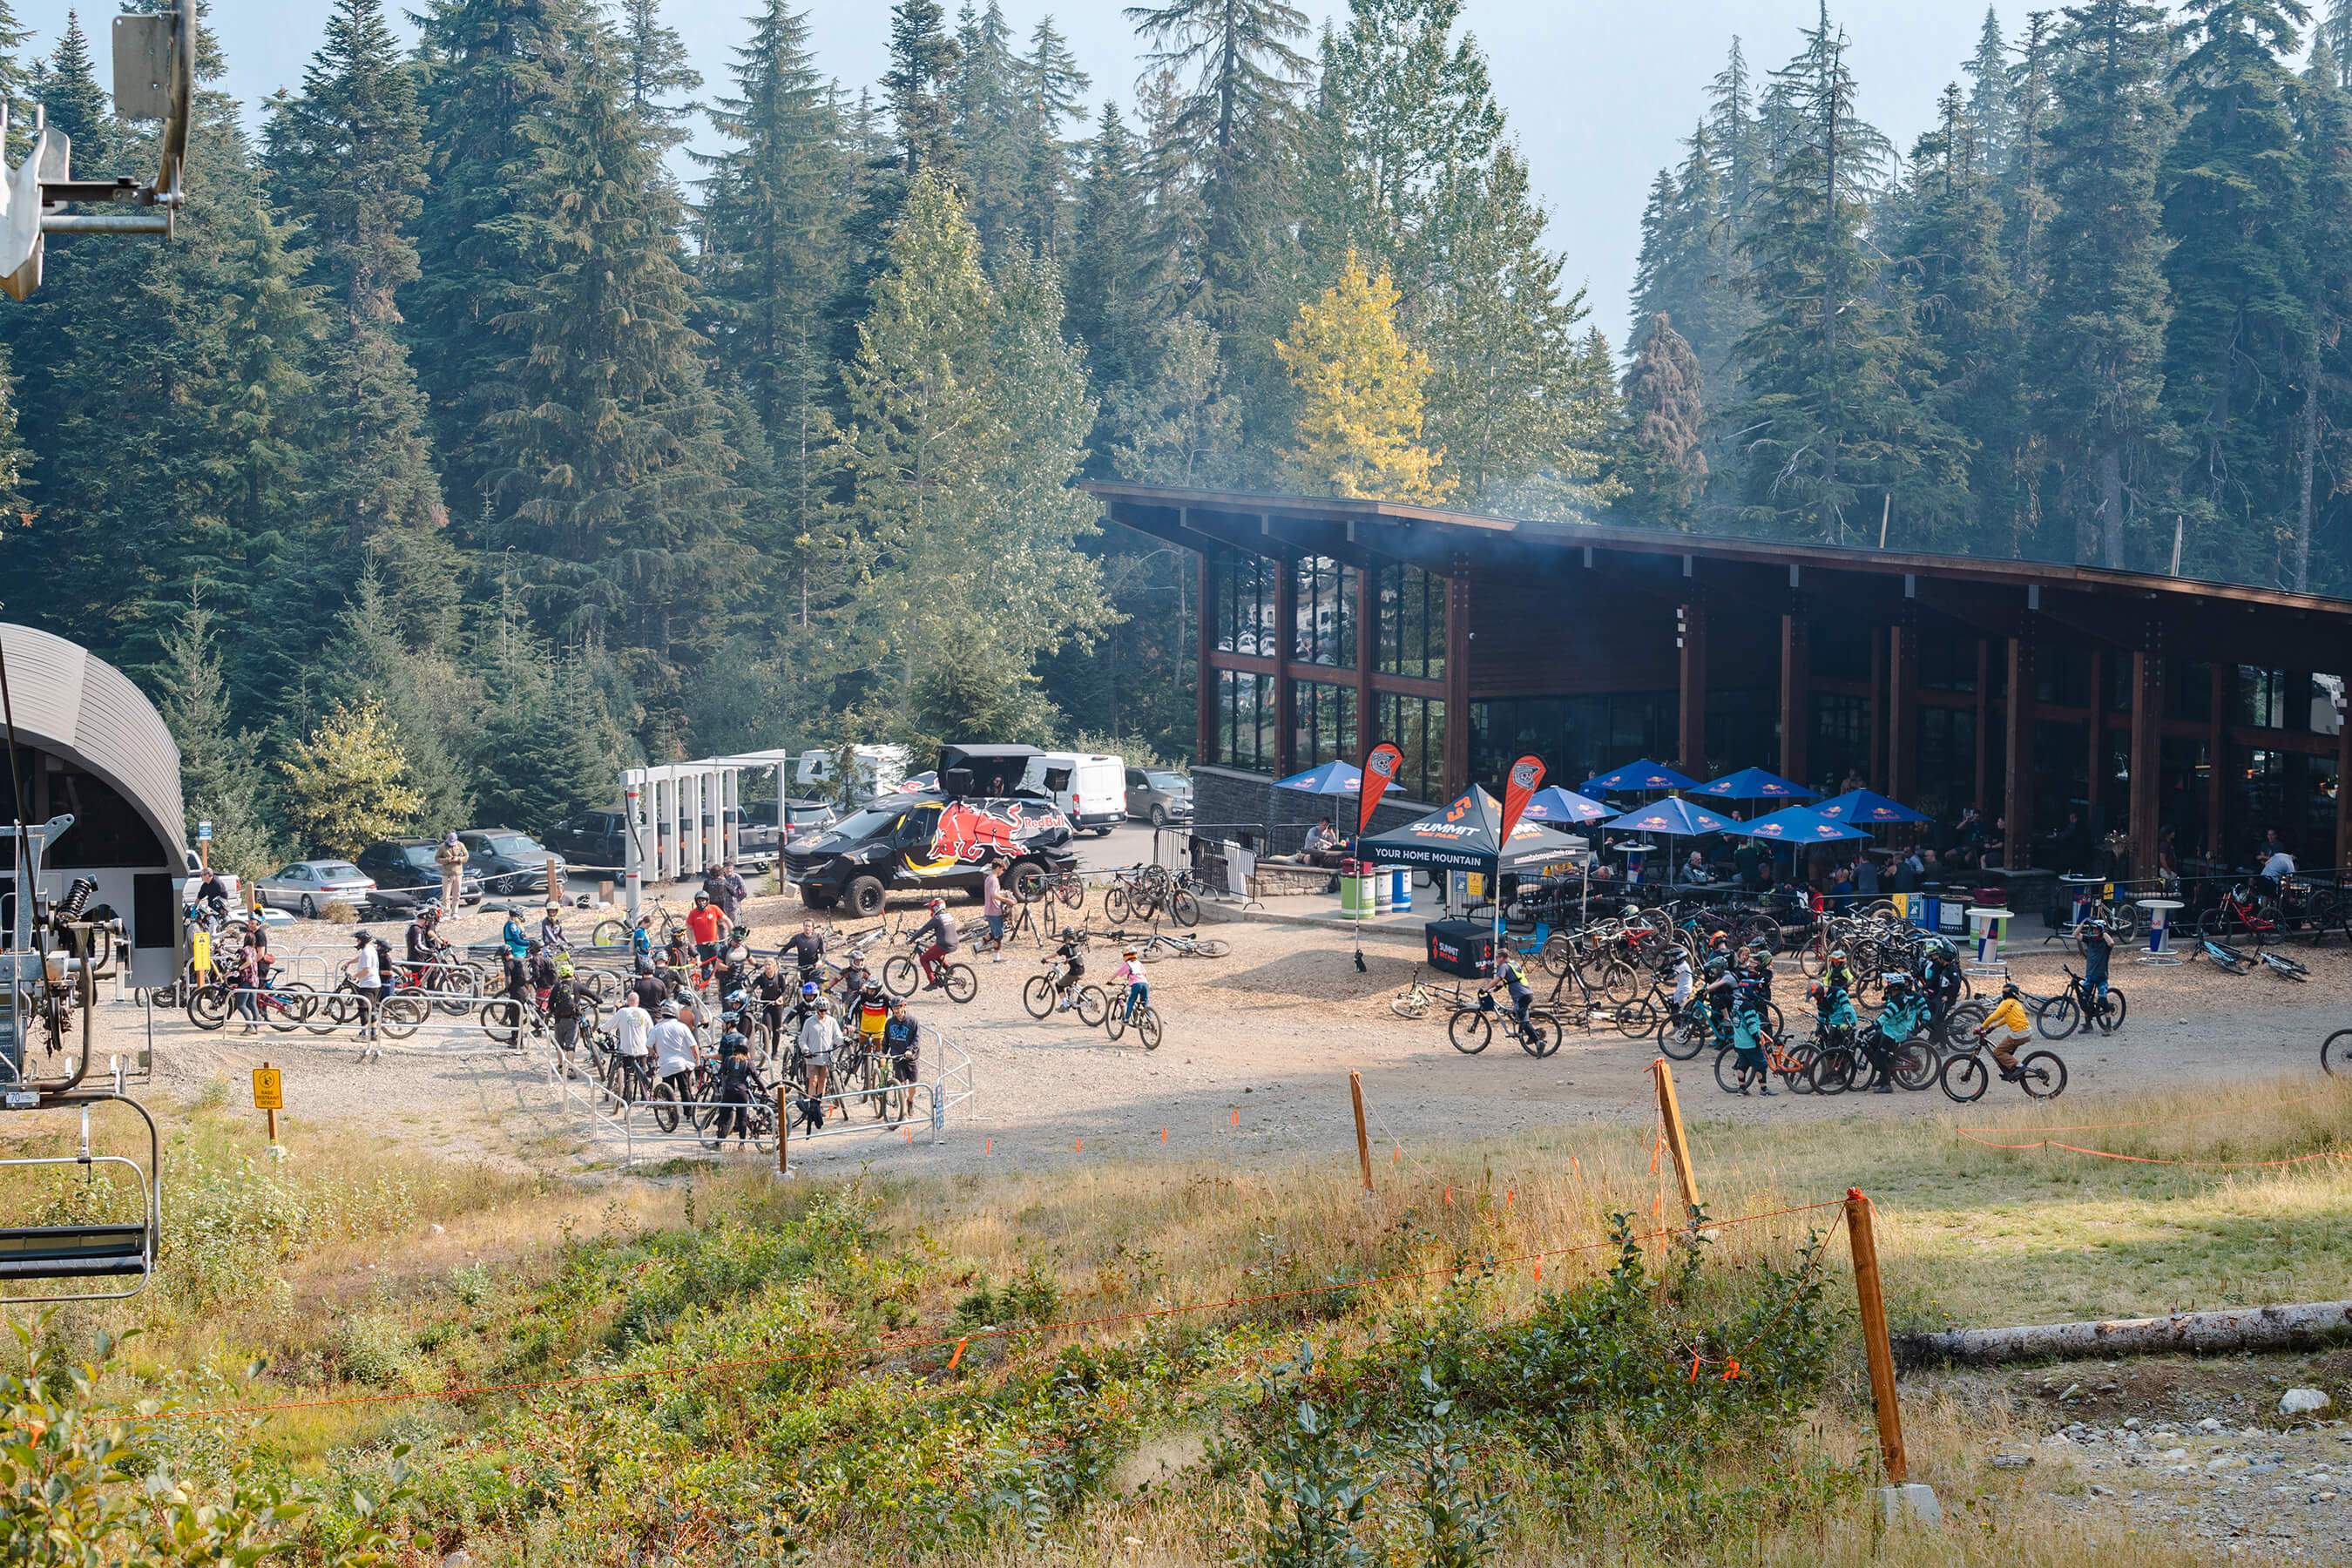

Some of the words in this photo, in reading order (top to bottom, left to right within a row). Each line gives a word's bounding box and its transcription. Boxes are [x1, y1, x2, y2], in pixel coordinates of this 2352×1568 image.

[1409, 823, 1481, 836] SUMMIT
[1434, 832, 1461, 841] PARK
[1375, 848, 1401, 859] YOUR
[1402, 851, 1430, 862] HOME
[1432, 853, 1482, 867] MOUNTAIN
[1439, 942, 1459, 956] SUMMIT
[10, 1092, 21, 1102] 70
